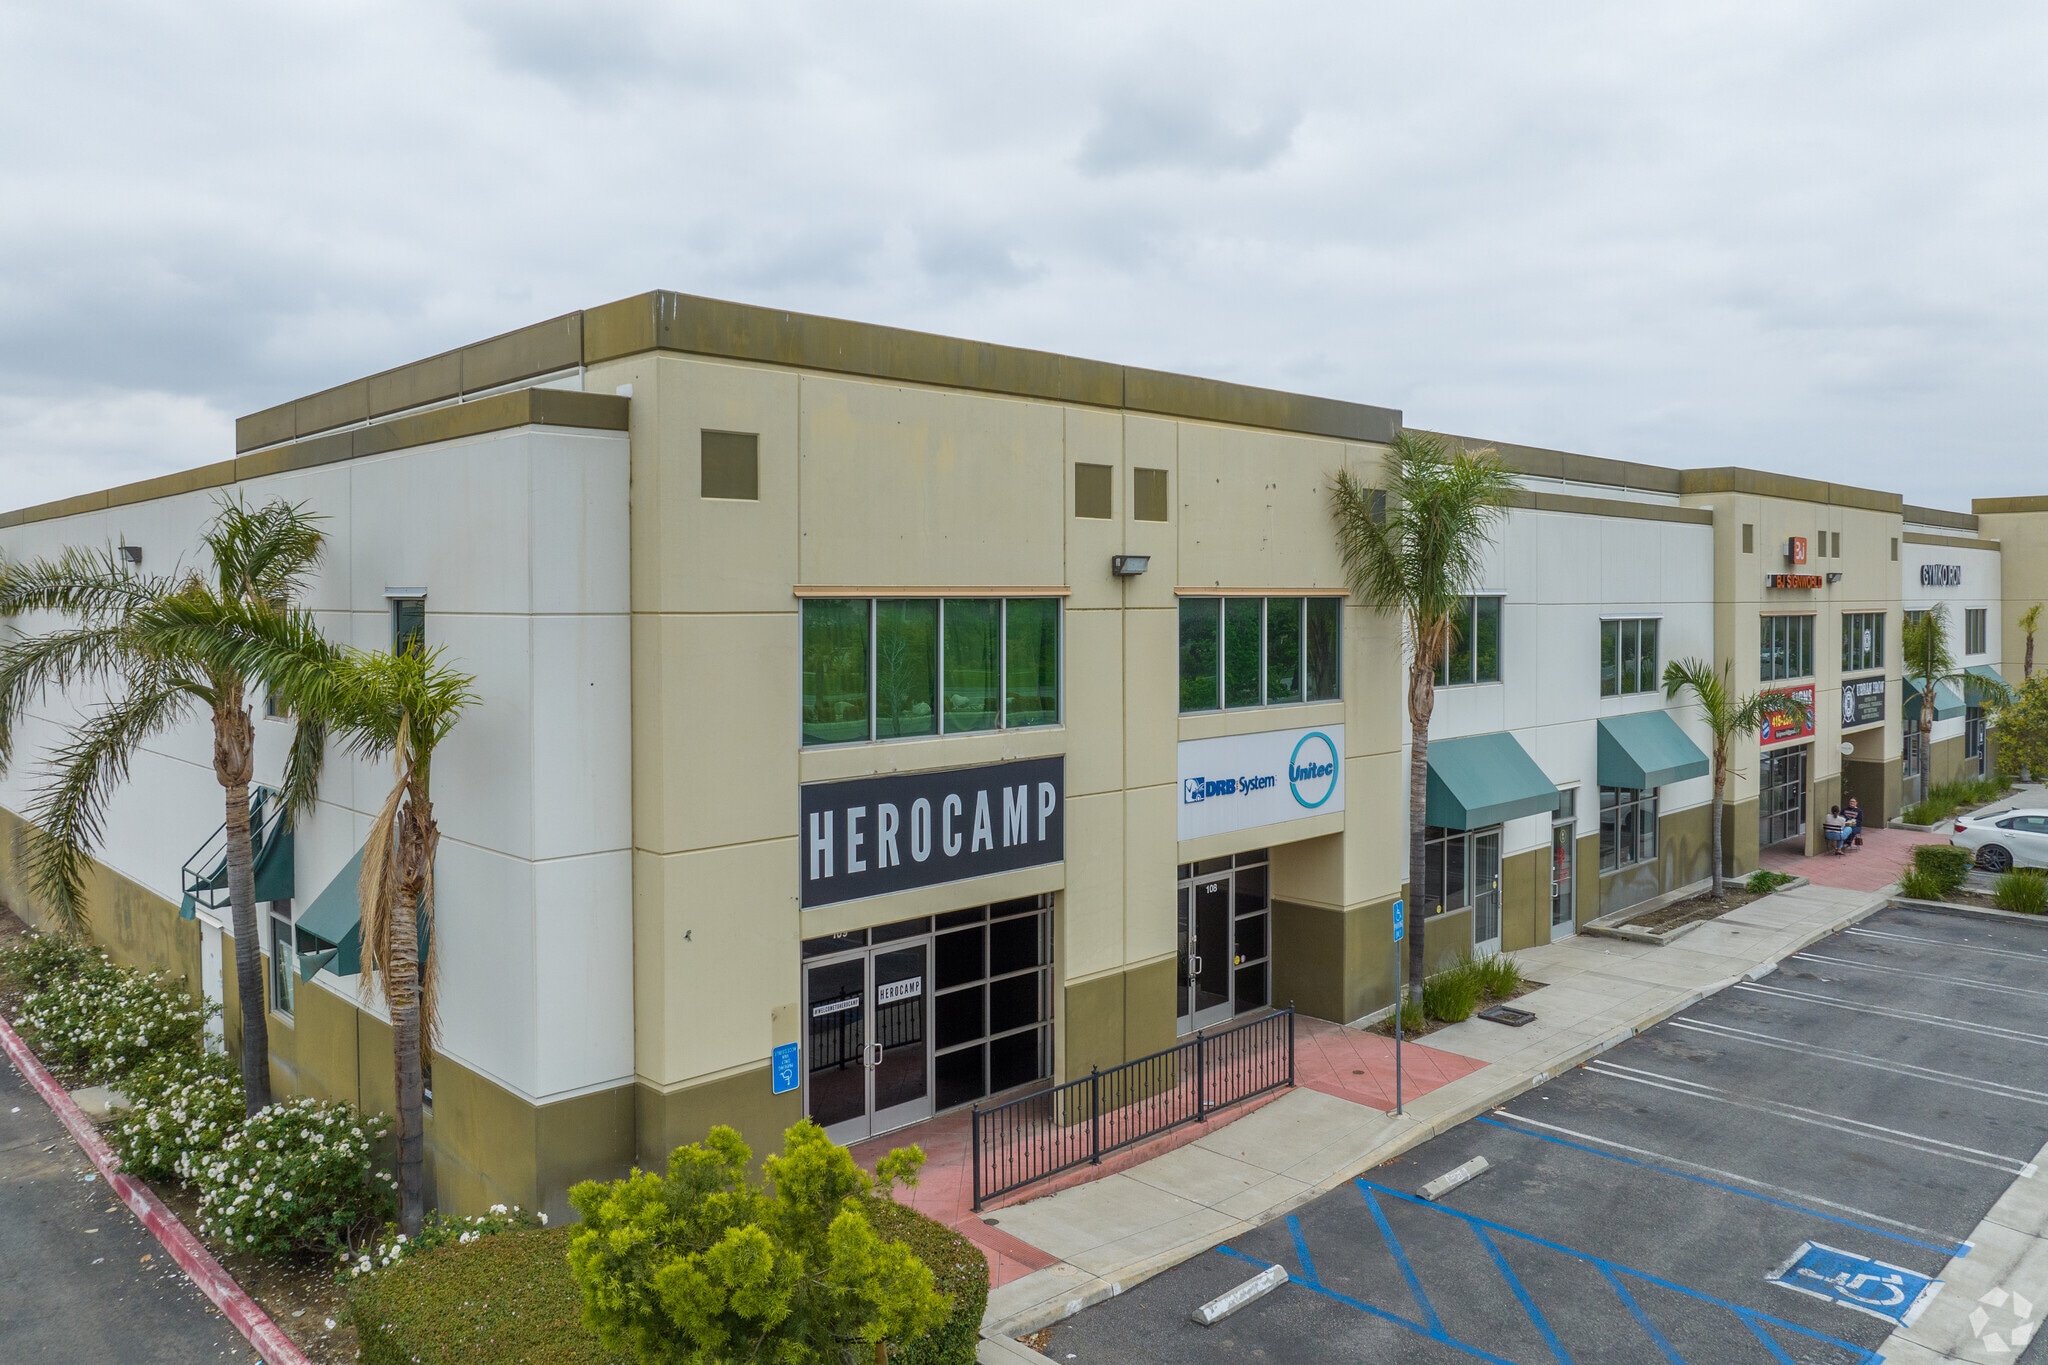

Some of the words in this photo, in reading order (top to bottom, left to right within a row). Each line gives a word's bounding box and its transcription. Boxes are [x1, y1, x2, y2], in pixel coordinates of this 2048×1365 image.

[1289, 762, 1334, 783] Unitec
[1206, 778, 1236, 797] DRB
[810, 782, 1056, 880] HEROCAMP
[1206, 883, 1218, 894] 108
[880, 981, 920, 1000] HEROCAMP
